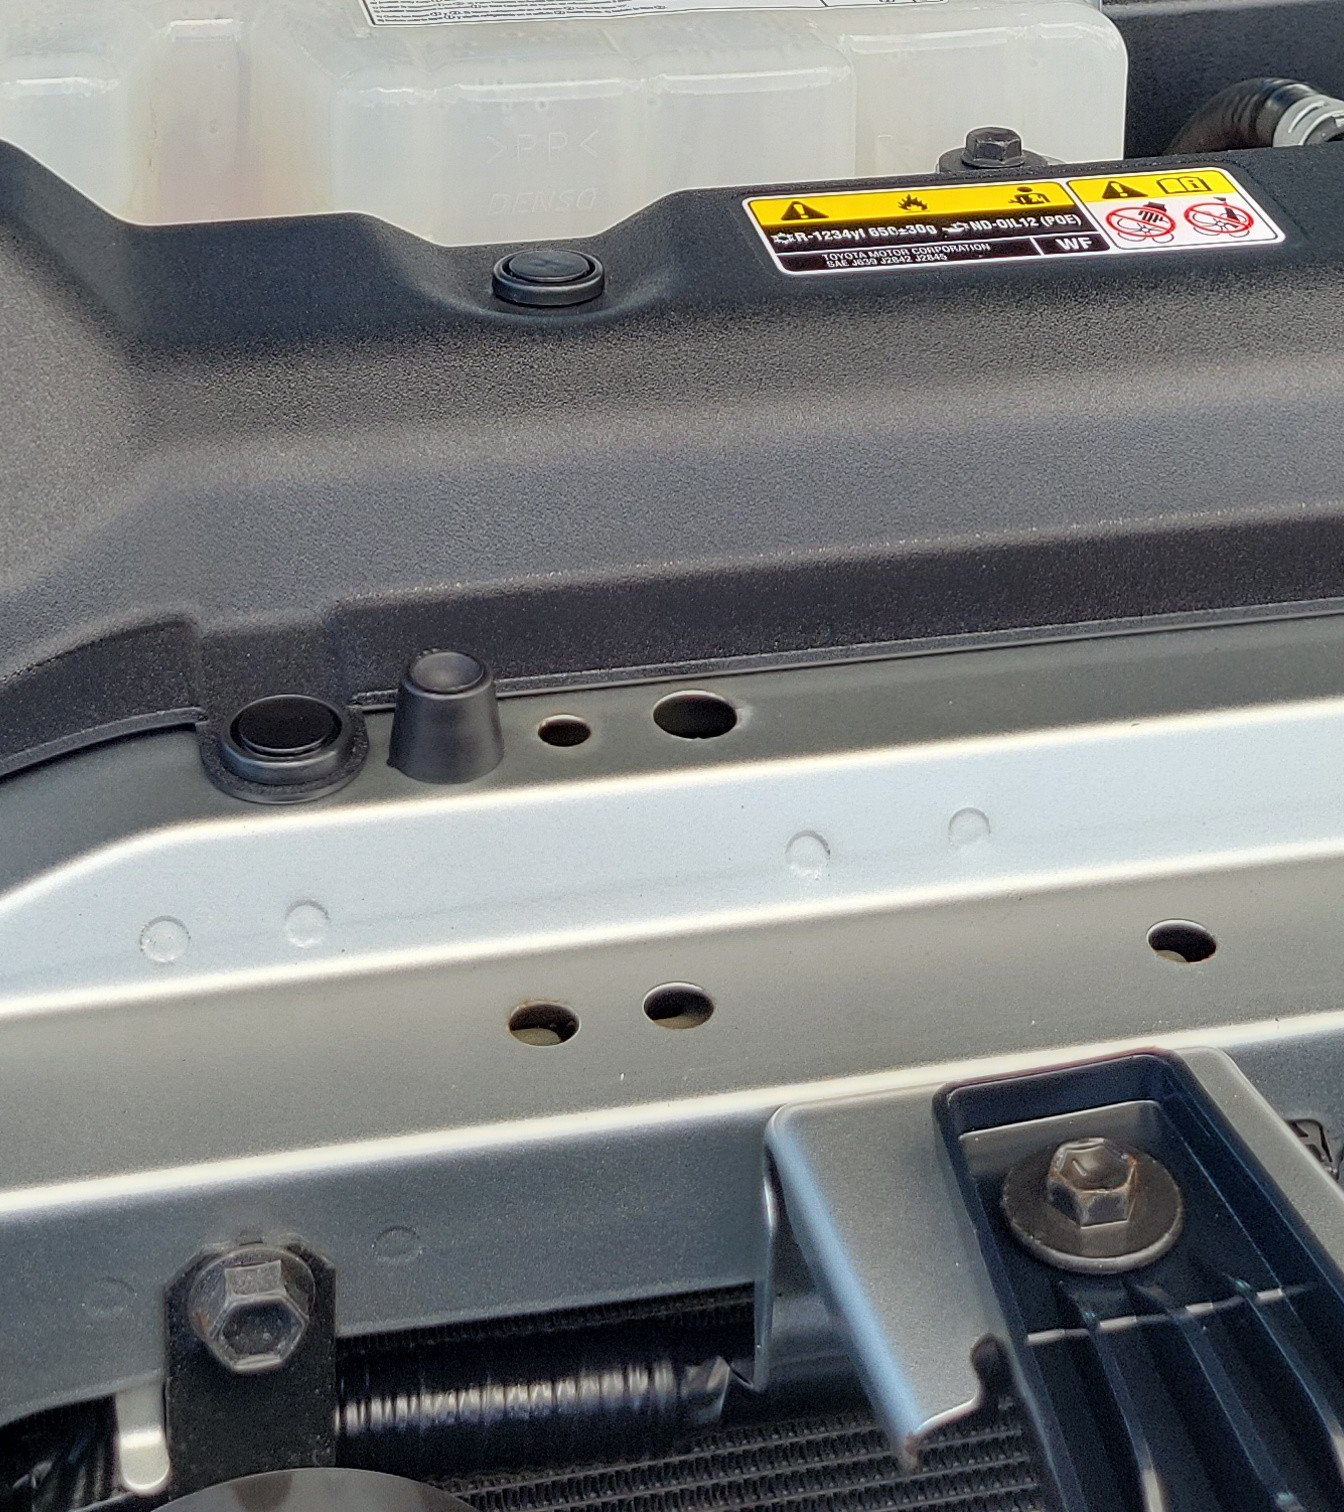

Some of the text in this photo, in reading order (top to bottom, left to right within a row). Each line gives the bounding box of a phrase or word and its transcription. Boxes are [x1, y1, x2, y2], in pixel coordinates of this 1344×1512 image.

[487, 187, 599, 215] DENSO
[968, 217, 1039, 231] ND-OIL12
[1041, 214, 1082, 227] (POE)
[822, 244, 991, 261] TOYOTA MOTOR CORPORATION
[1056, 237, 1093, 251] WF
[826, 259, 850, 268] SAE
